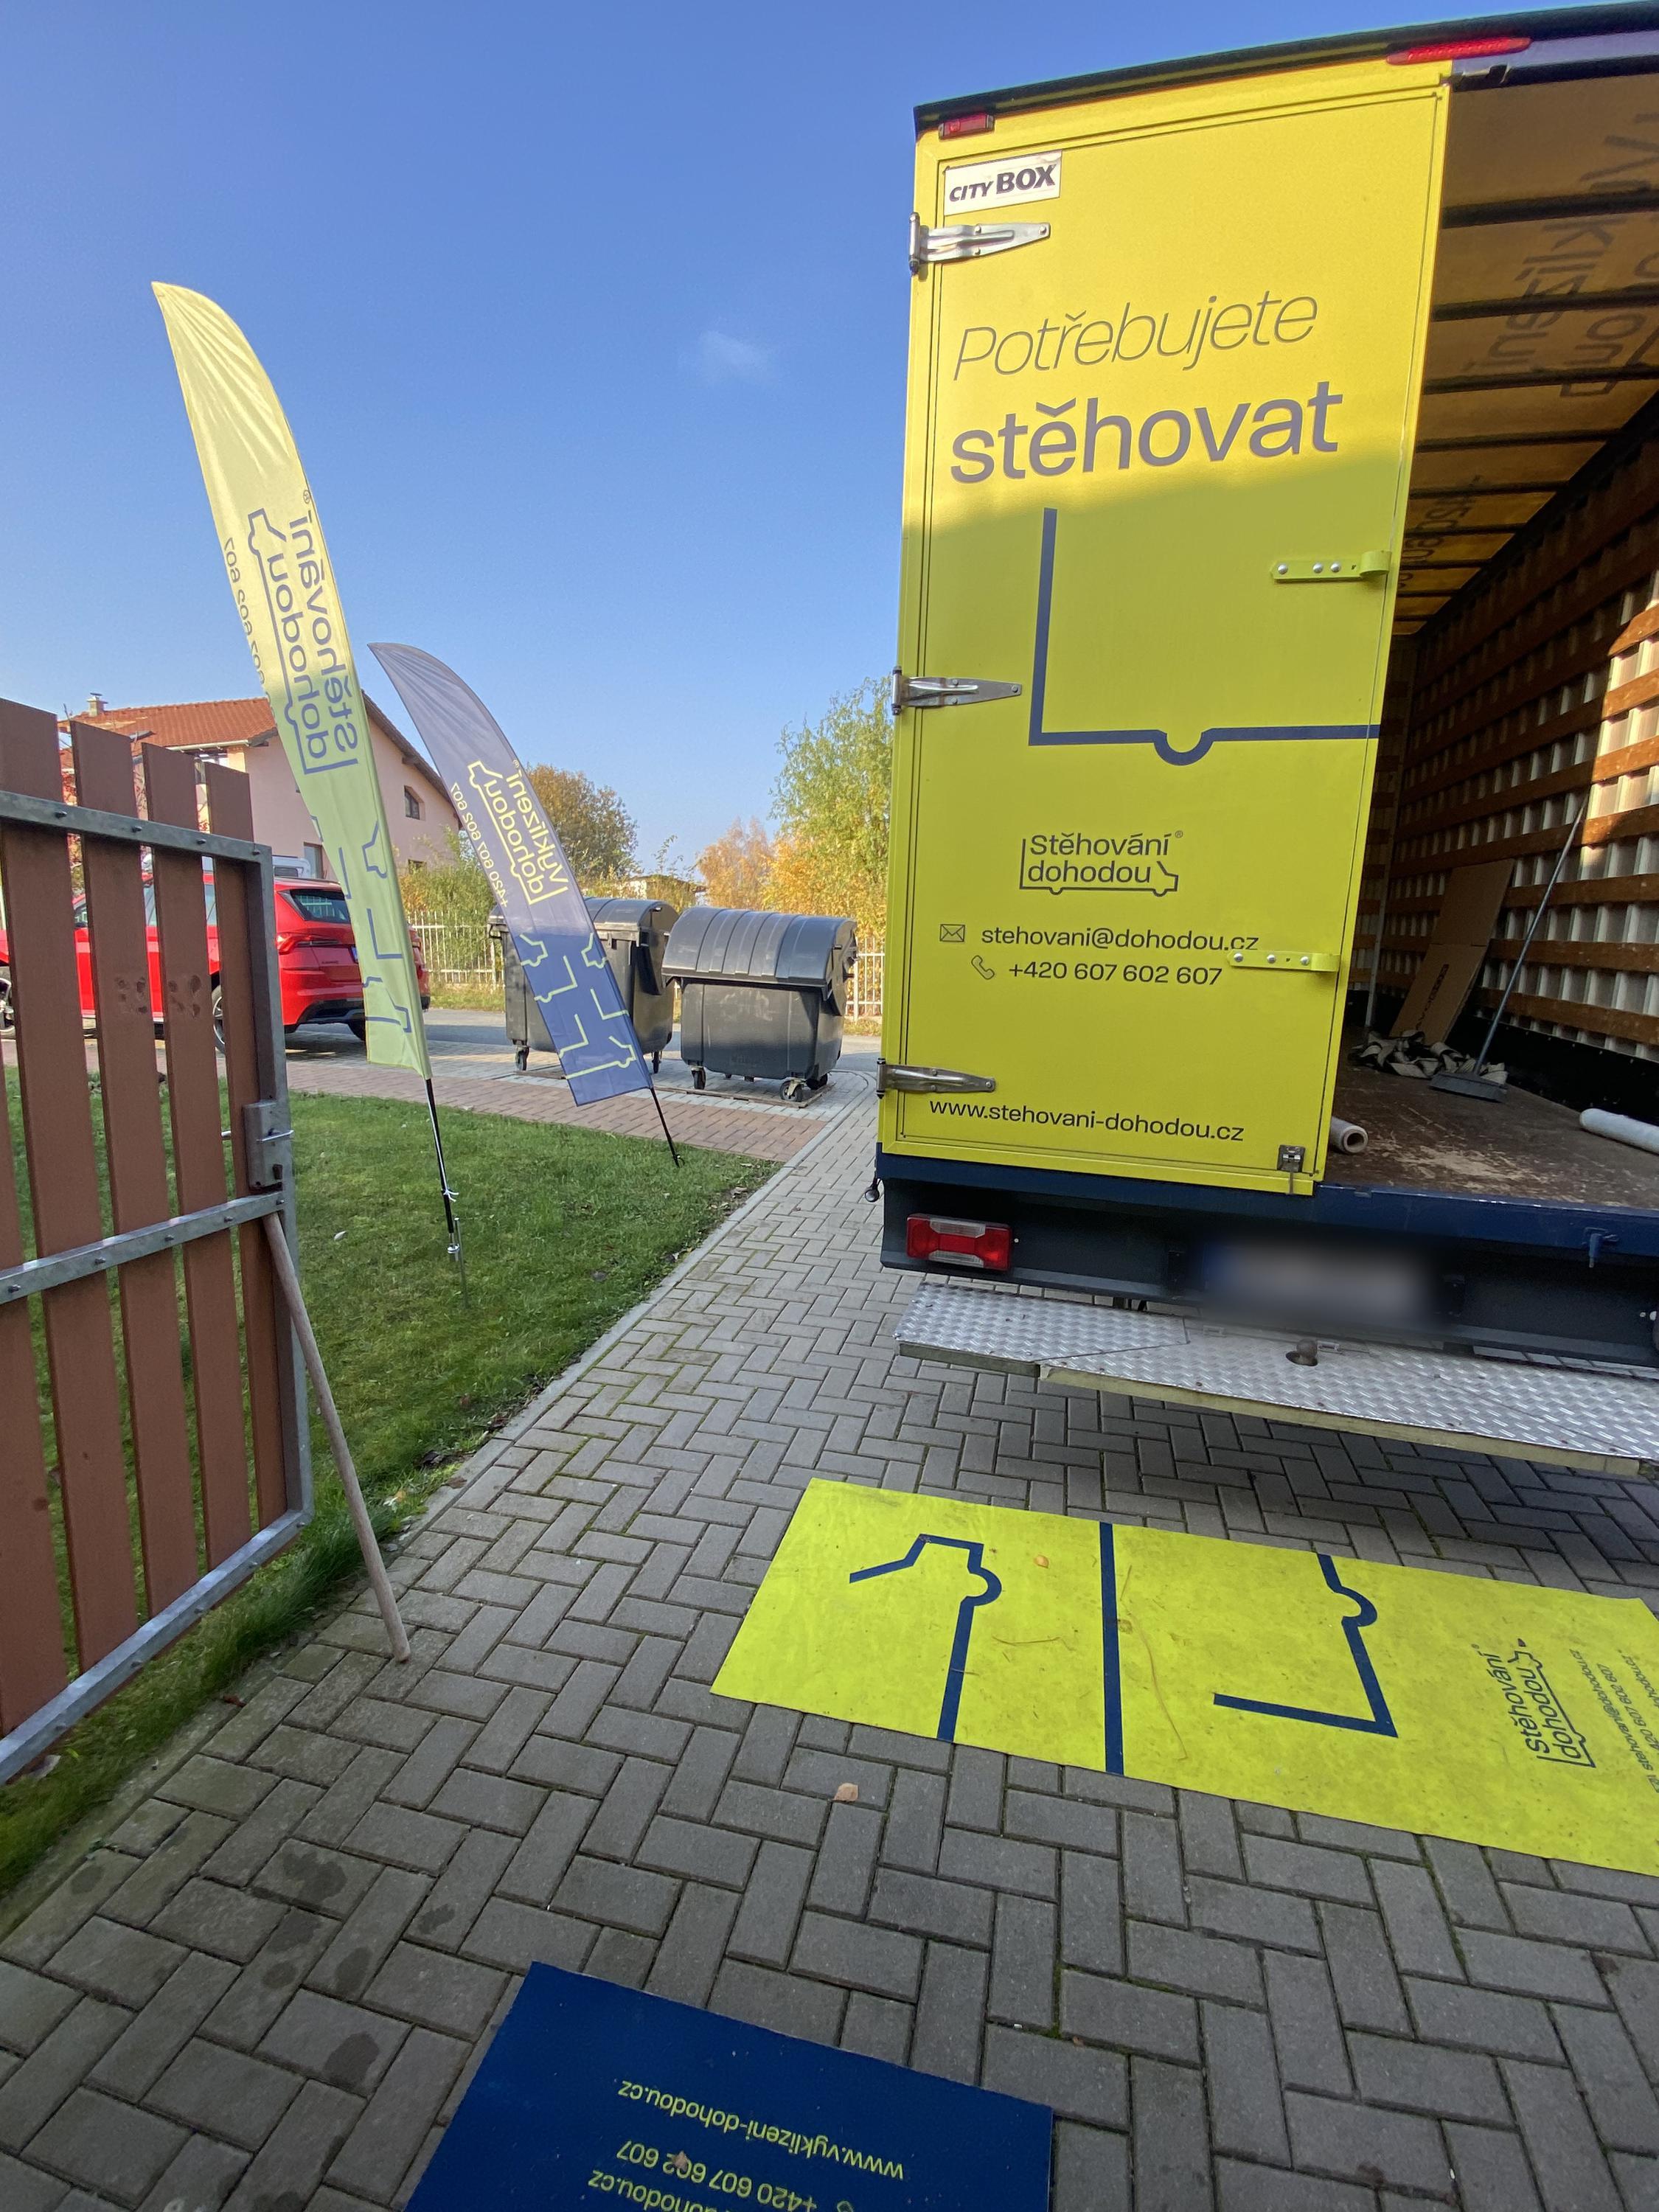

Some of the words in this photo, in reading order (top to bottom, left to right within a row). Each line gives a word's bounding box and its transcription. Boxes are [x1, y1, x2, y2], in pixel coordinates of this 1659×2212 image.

[949, 181, 994, 202] CITY
[996, 164, 1057, 195] BOX
[953, 290, 1318, 381] Potřebujete
[950, 380, 1343, 484] stěhovat
[1029, 832, 1172, 857] Stěhování
[1027, 860, 1152, 884] dohodou
[981, 926, 1259, 951] stehovani@dohodou.cz
[1009, 961, 1067, 980] +420
[1074, 963, 1118, 981] 607
[1123, 964, 1169, 984] 602
[1177, 966, 1223, 985] 607
[929, 1099, 1245, 1142] www.stehovani-dohodou.cz
[1596, 1663, 1618, 1683] 607
[1478, 1650, 1550, 1753] Stěhování
[1516, 1666, 1582, 1759] dohodou
[618, 2080, 905, 2180] www.vyklizeni-dohodou.cz
[616, 2140, 660, 2168] 607
[662, 2151, 707, 2184] 602
[708, 2169, 752, 2199] 607
[756, 2183, 817, 2212] +420
